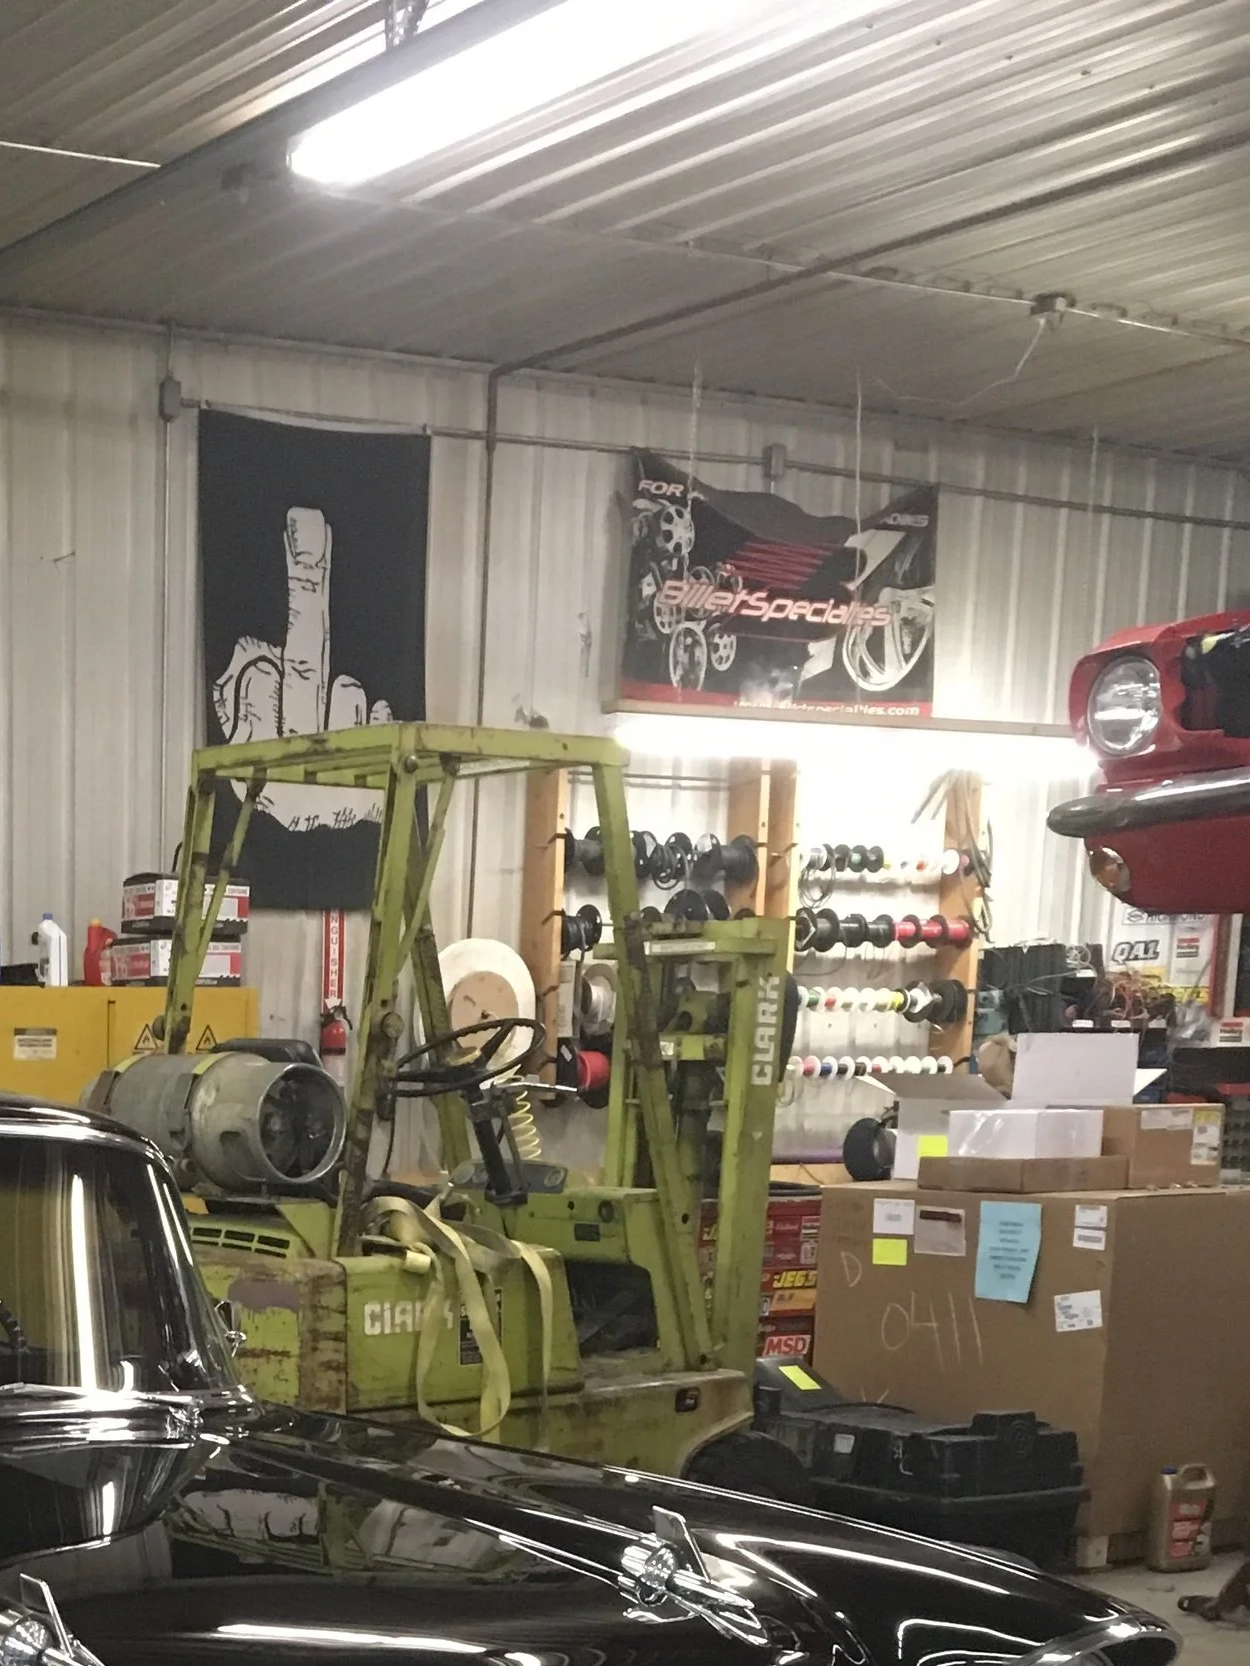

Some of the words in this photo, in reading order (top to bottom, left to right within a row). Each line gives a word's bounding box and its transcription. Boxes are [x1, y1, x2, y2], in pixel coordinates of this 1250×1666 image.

[637, 479, 685, 498] FOR
[329, 912, 340, 998] NGUISHER
[1111, 939, 1160, 966] QA1
[750, 975, 780, 1086] CLARK
[764, 1335, 808, 1356] MSD
